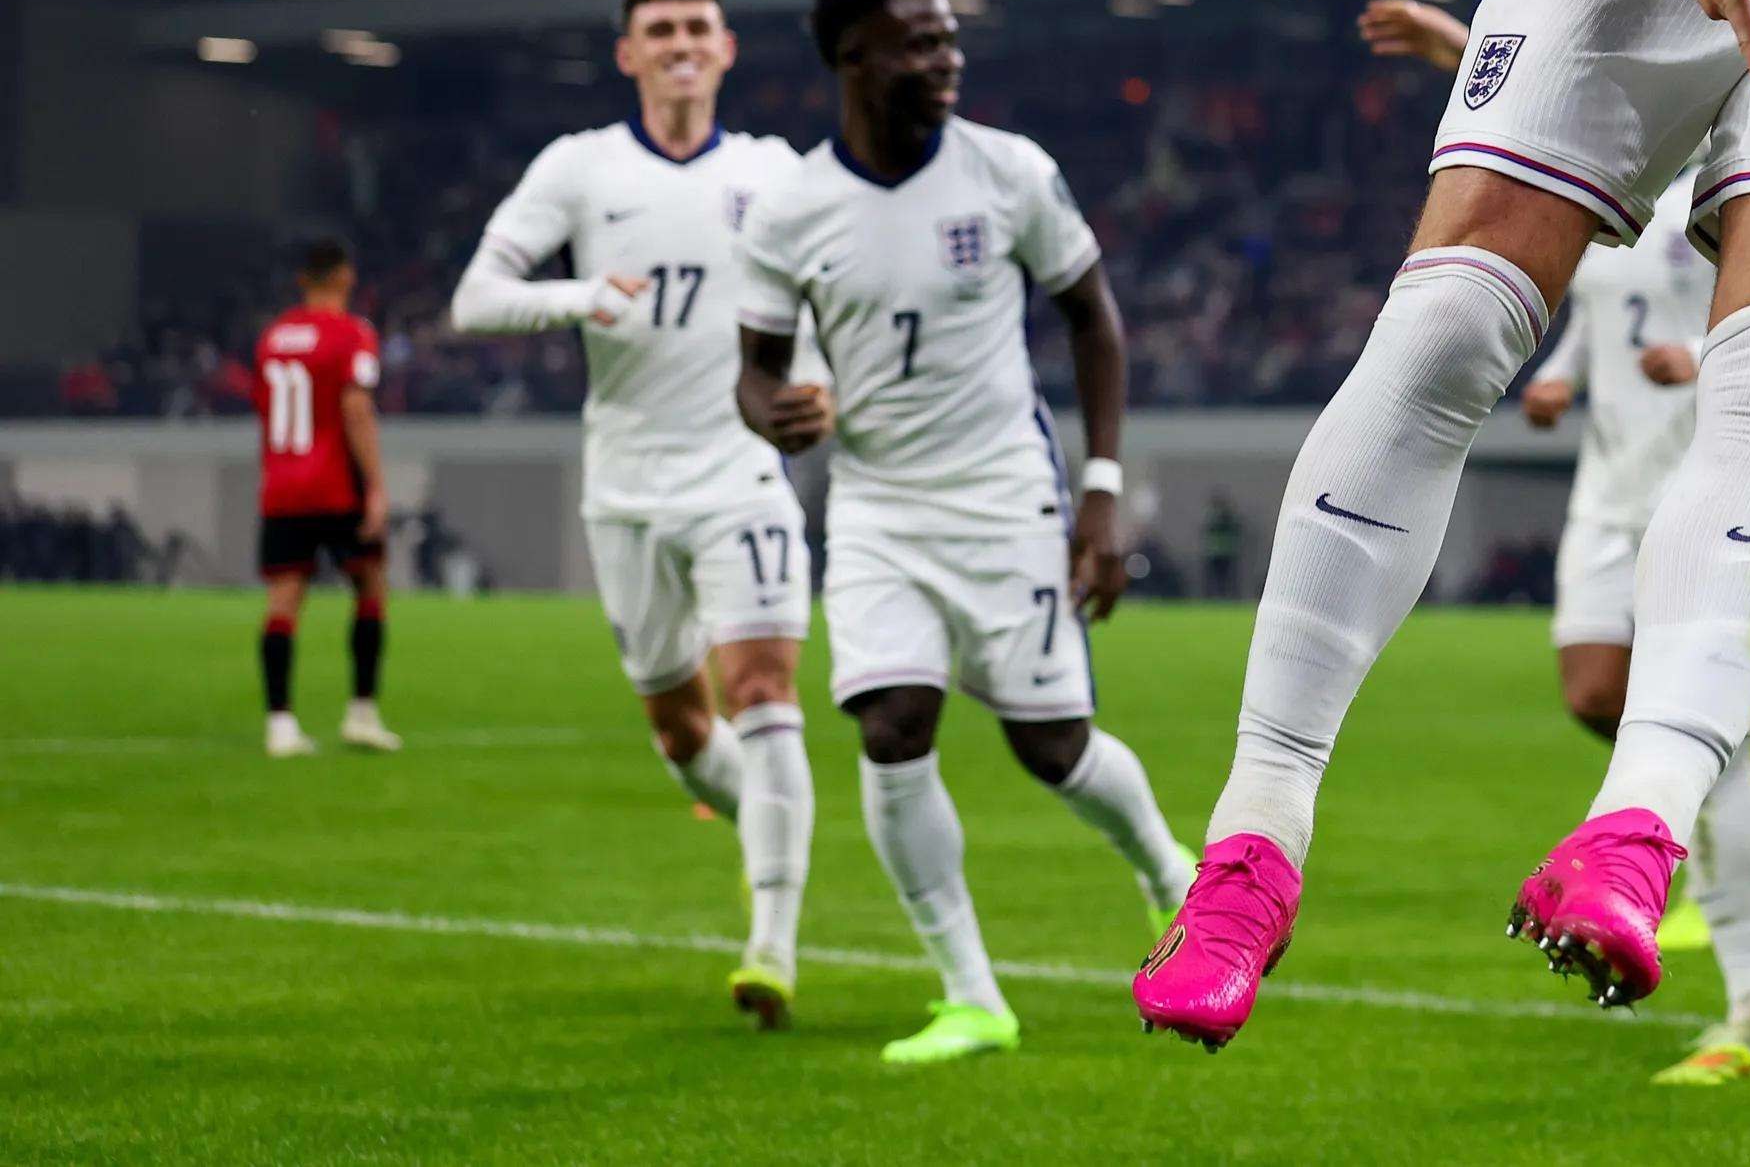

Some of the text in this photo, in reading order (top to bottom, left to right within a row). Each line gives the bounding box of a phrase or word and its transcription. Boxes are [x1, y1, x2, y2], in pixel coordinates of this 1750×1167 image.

[649, 262, 705, 327] 17
[892, 309, 921, 377] 7
[263, 357, 315, 455] 11
[739, 524, 787, 584] 17
[1032, 586, 1057, 654] 7
